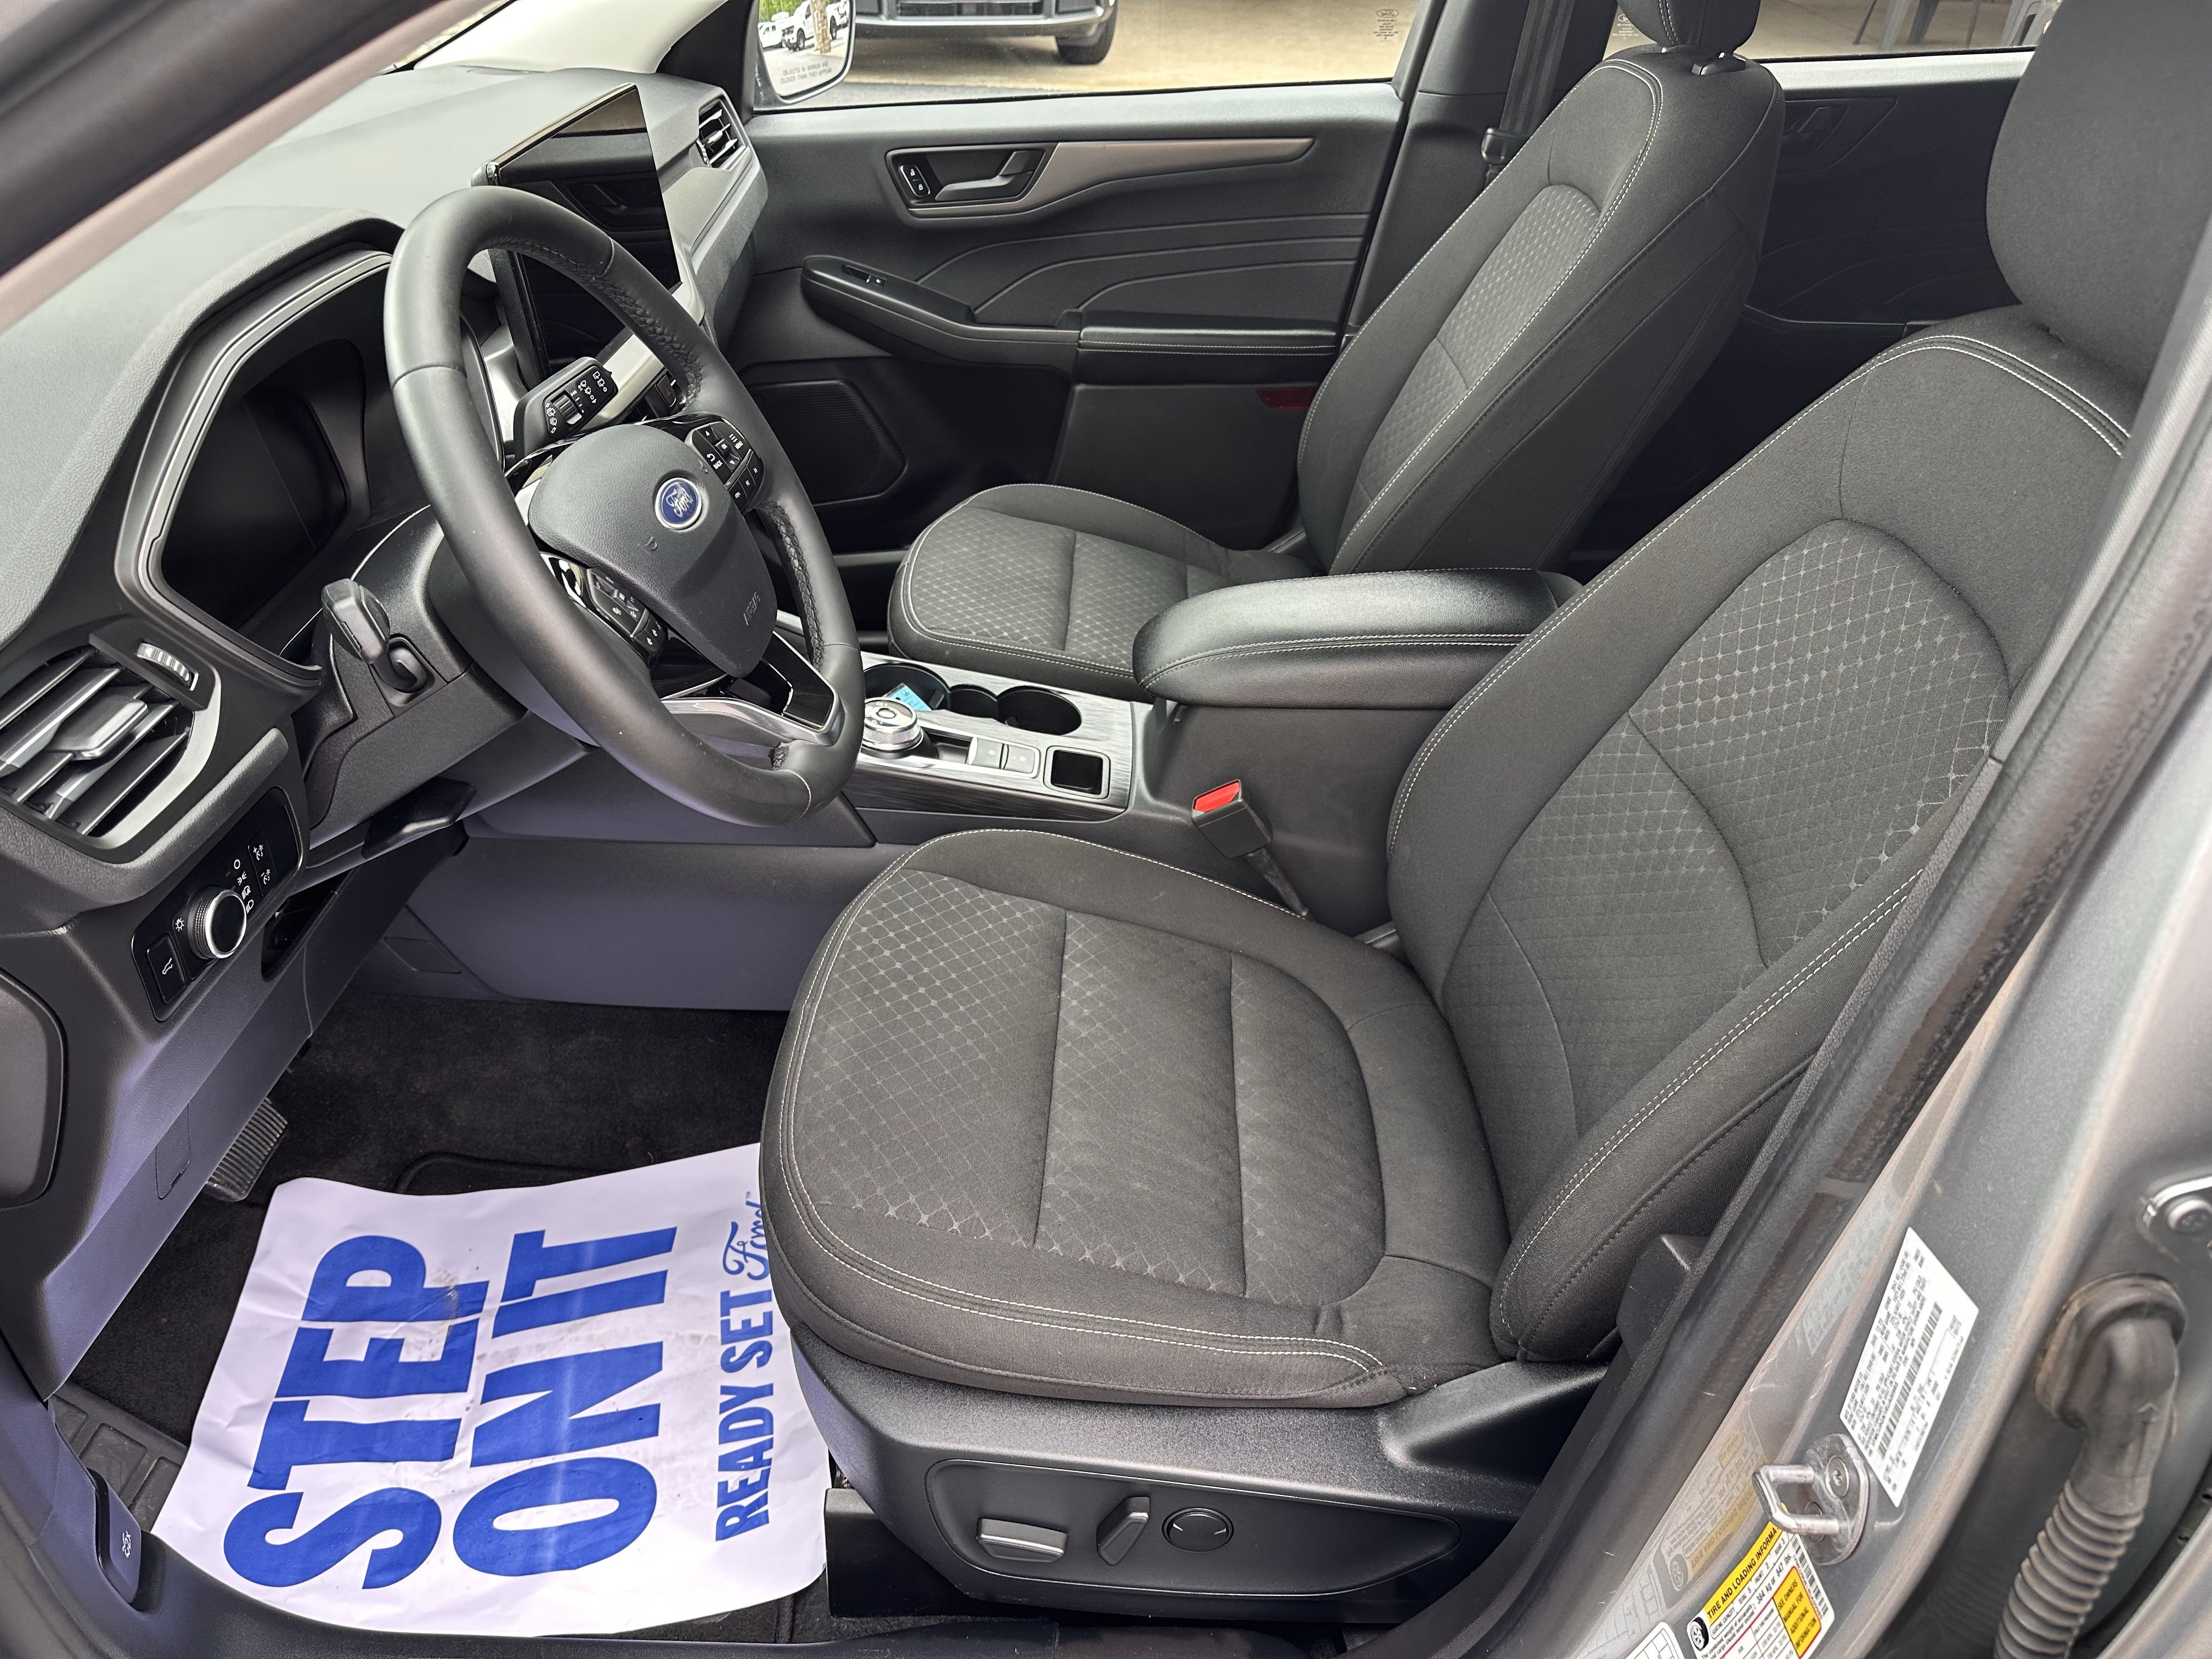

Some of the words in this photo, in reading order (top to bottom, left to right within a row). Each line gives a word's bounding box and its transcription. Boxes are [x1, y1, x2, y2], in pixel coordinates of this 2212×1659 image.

[665, 487, 694, 518] Ford
[713, 460, 723, 470] BACK
[492, 1226, 677, 1338] IT
[719, 1290, 774, 1373] SET
[224, 1235, 489, 1589] STEP
[453, 1341, 664, 1577] ON
[715, 1382, 775, 1542] READY
[1707, 1603, 1722, 1619] TIRE
[1721, 1588, 1733, 1603] AND
[1732, 1559, 1756, 1590] LOADING
[1756, 1527, 1779, 1561] INFORMA
[1757, 1590, 1765, 1605] 384
[1766, 1582, 1773, 1594] kg
